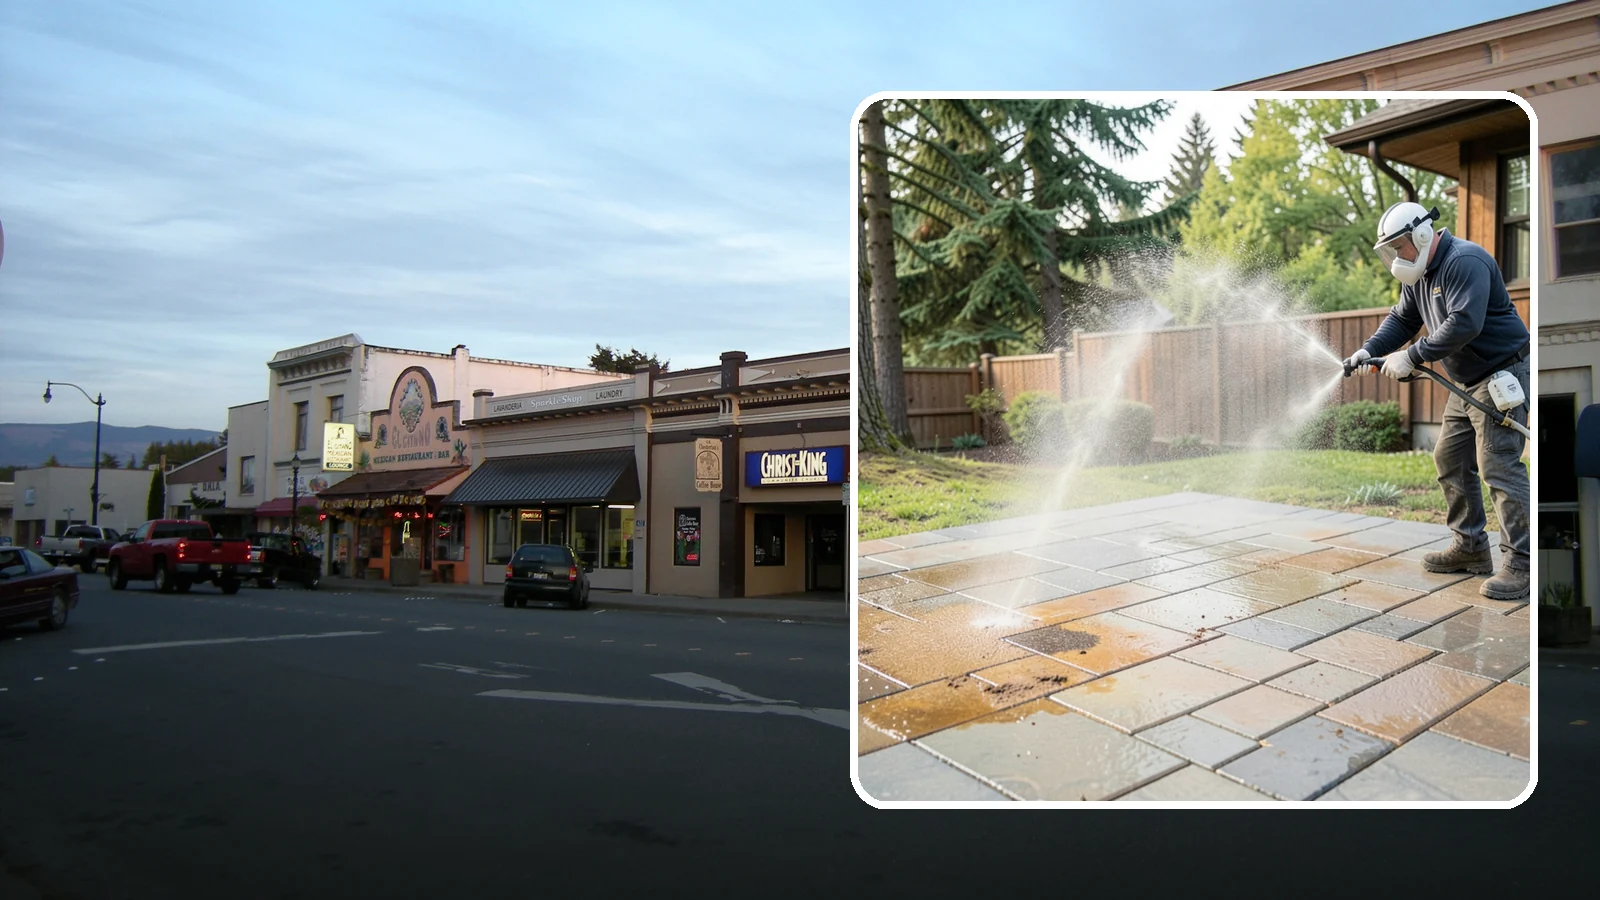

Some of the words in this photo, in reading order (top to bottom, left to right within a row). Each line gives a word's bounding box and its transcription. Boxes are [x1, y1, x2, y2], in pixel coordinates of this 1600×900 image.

[595, 389, 623, 400] LAUNDRY
[493, 402, 523, 412] LAVANDERIA
[531, 399, 560, 409] Sparkle
[563, 394, 582, 404] Shop
[397, 452, 433, 462] RESTAURANT
[438, 450, 450, 459] BAR
[761, 452, 797, 478] CHRIST
[799, 450, 827, 476] KING
[696, 481, 709, 489] Coffee
